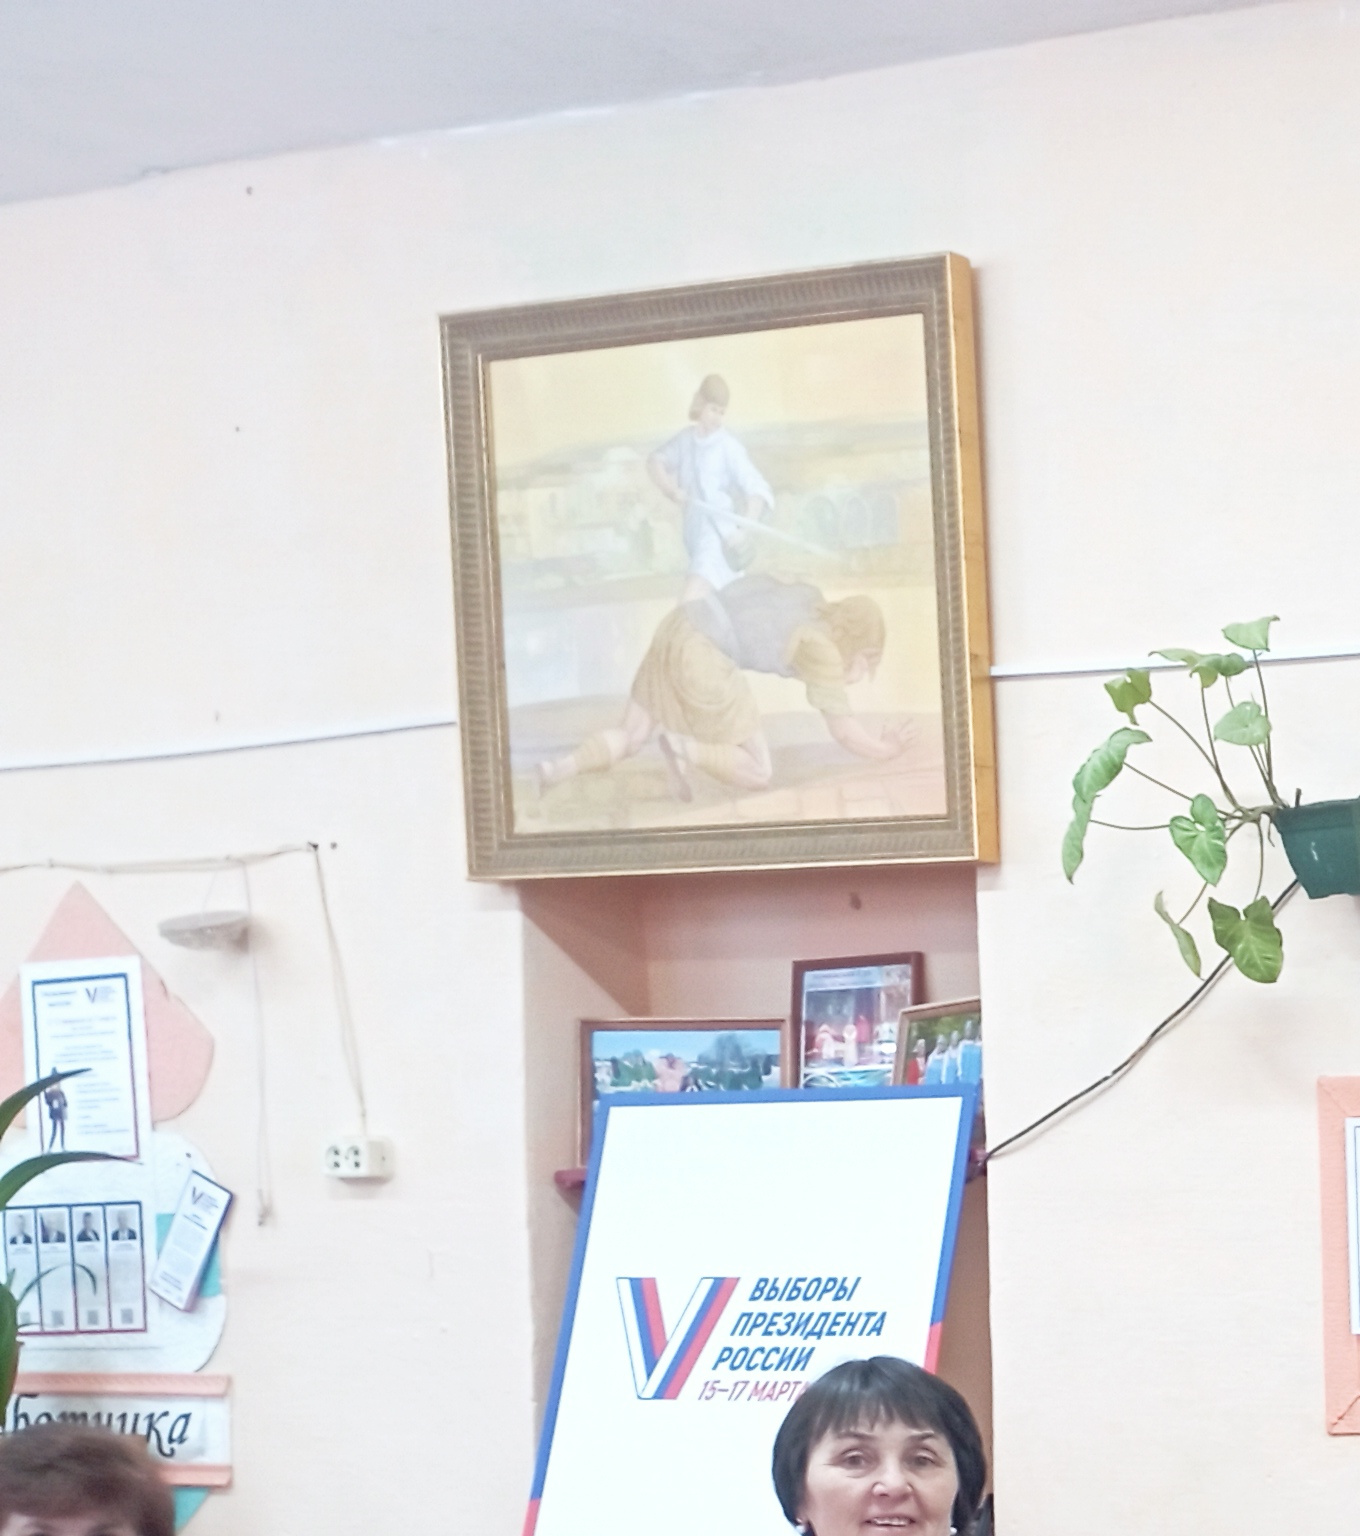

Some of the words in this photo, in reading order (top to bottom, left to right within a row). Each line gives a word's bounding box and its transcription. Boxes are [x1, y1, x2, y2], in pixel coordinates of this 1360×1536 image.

[748, 1276, 862, 1302] ВЫБОРЫ
[729, 1311, 888, 1341] ПРЕЗИДЕНТА
[711, 1346, 816, 1372] РОССИИ
